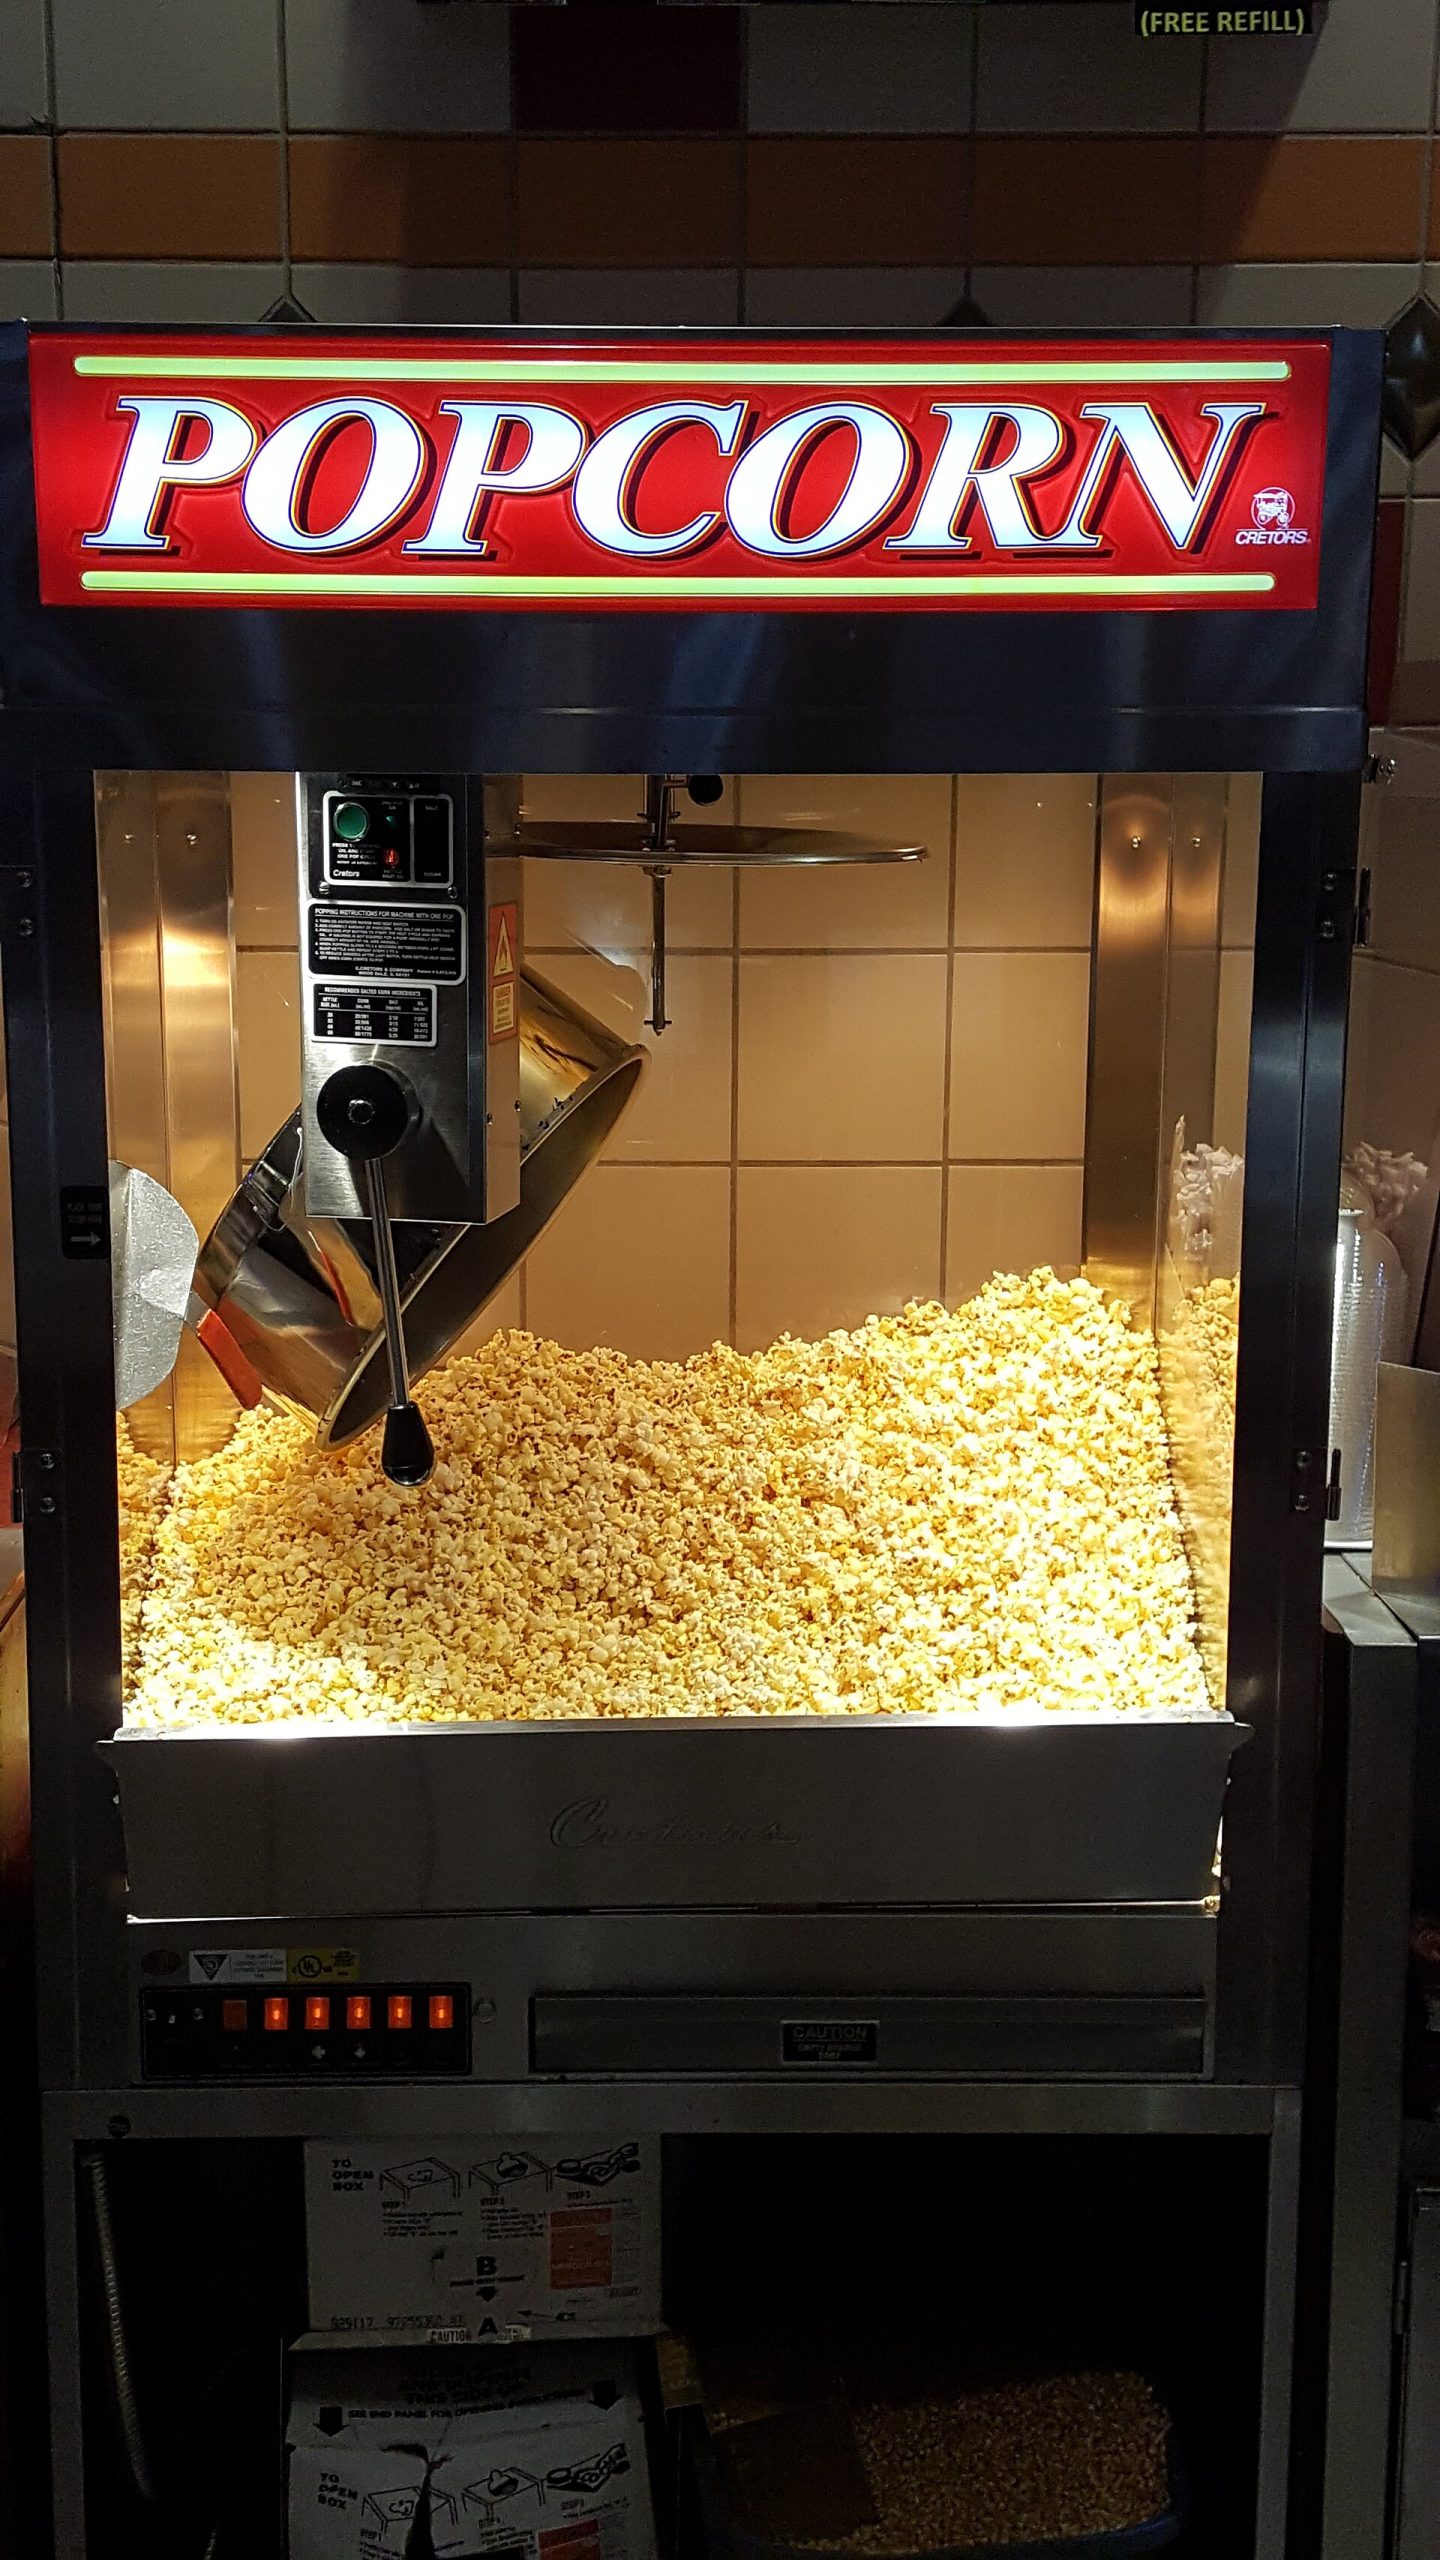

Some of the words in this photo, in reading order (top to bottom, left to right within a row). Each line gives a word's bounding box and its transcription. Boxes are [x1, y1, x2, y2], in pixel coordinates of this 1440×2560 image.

[1141, 10, 1210, 37] (FREE
[1216, 8, 1305, 36] REFILL)
[80, 395, 1266, 557] POPCORN
[1235, 530, 1308, 545] CRETORS
[332, 869, 360, 877] Cretors
[339, 909, 377, 917] INSTRUCTIONS
[792, 2025, 868, 2041] CAUTION
[331, 2158, 351, 2169] TO
[331, 2170, 374, 2180] OPEN
[333, 2182, 364, 2191] BOX
[476, 2256, 497, 2275] B
[478, 2317, 498, 2336] A
[348, 2409, 366, 2418] SEE
[370, 2409, 392, 2419] END
[395, 2409, 428, 2419] PANEL
[431, 2408, 453, 2418] FOR
[320, 2472, 340, 2483] TO
[318, 2484, 358, 2500] OPEN
[317, 2494, 347, 2510] BOX
